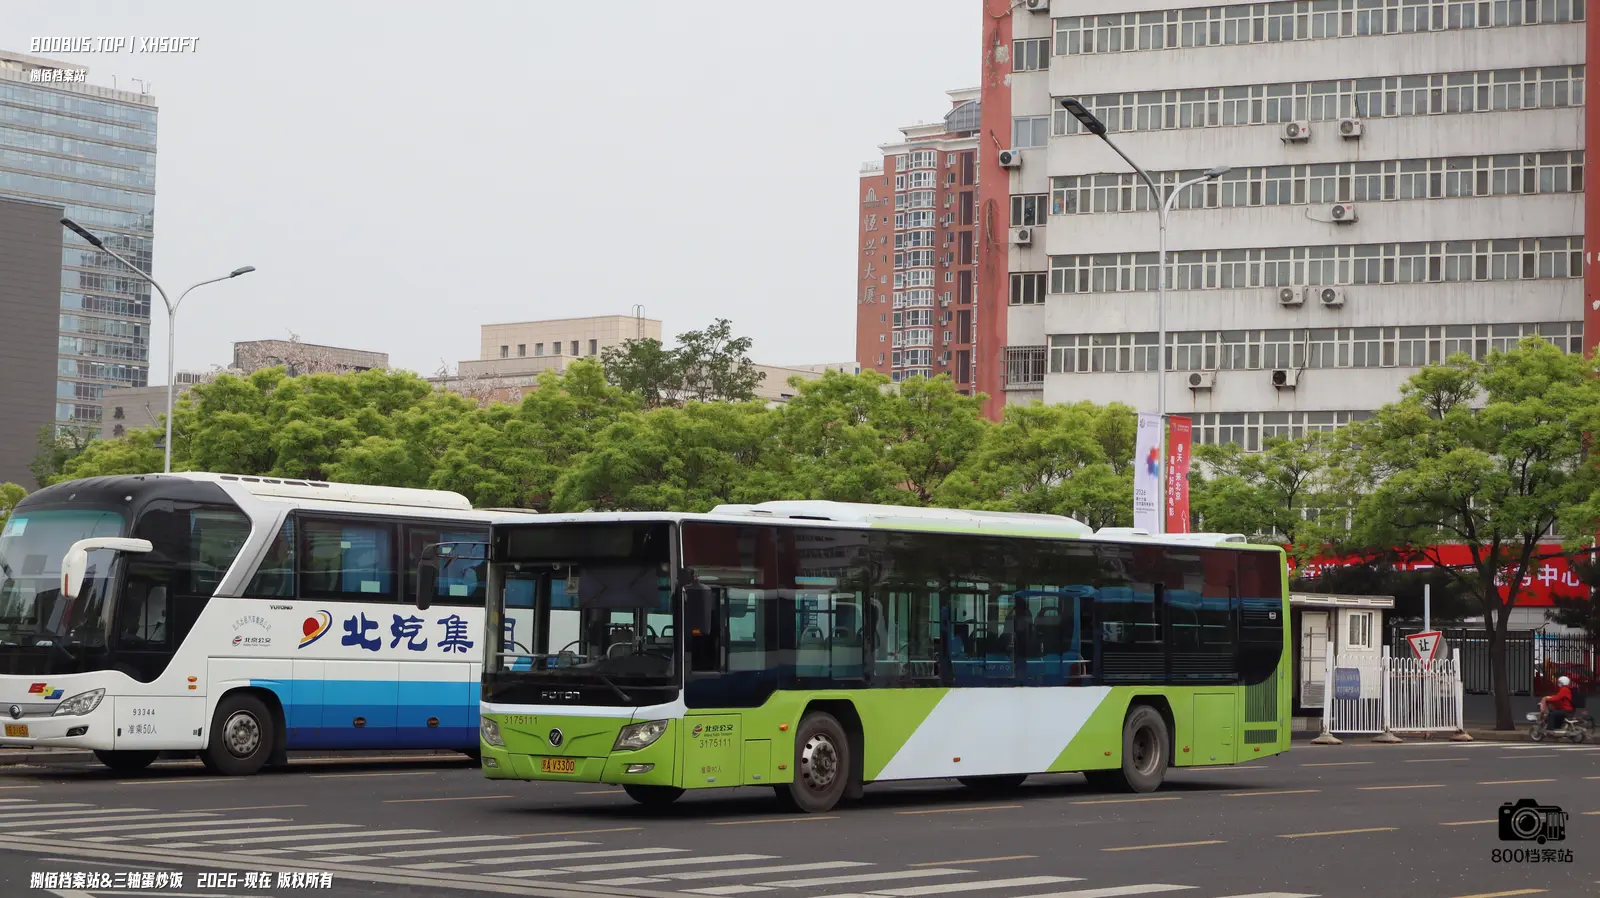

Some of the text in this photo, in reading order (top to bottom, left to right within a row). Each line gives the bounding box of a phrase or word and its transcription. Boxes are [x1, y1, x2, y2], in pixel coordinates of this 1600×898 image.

[1418, 639, 1430, 652] 让
[133, 708, 155, 716] 93344
[504, 715, 538, 725] 3175111
[705, 724, 733, 732] 北京公交
[699, 738, 731, 748] 3175111
